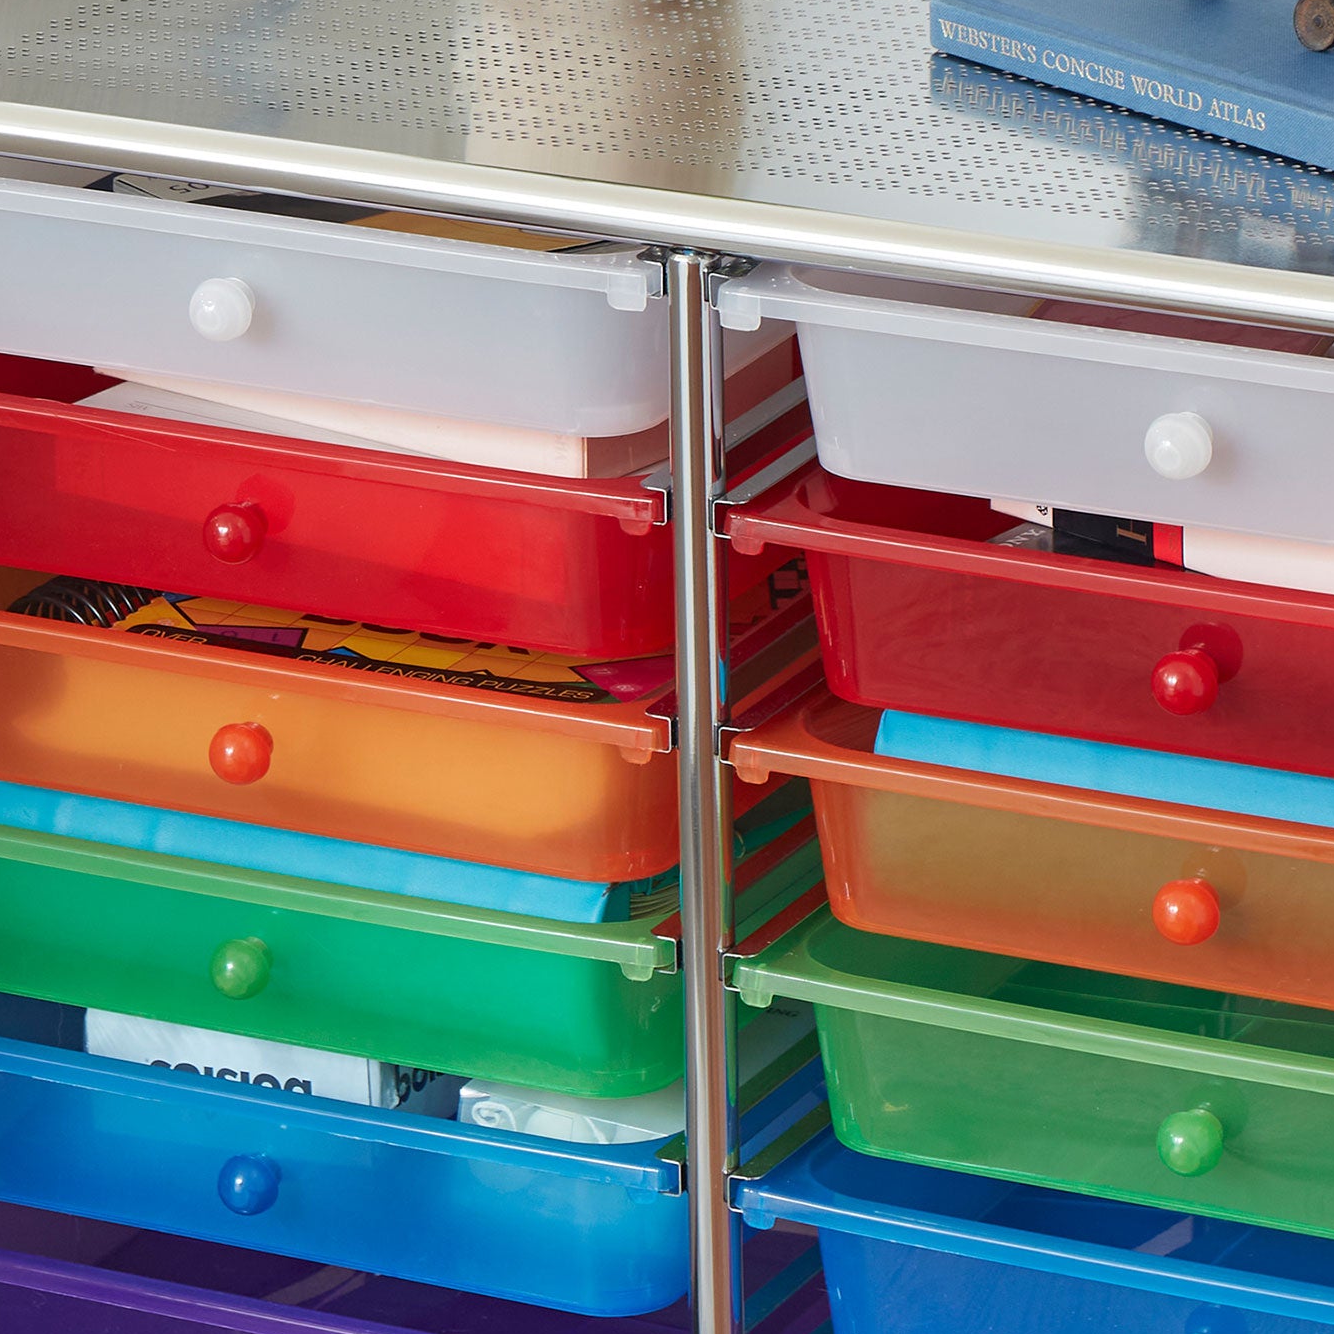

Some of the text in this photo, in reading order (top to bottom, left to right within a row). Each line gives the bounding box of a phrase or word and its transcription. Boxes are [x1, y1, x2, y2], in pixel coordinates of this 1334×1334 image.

[938, 18, 1266, 131] WEBSTER'S CONCISE WORLD ATLAS
[476, 679, 595, 700] PUZZLES
